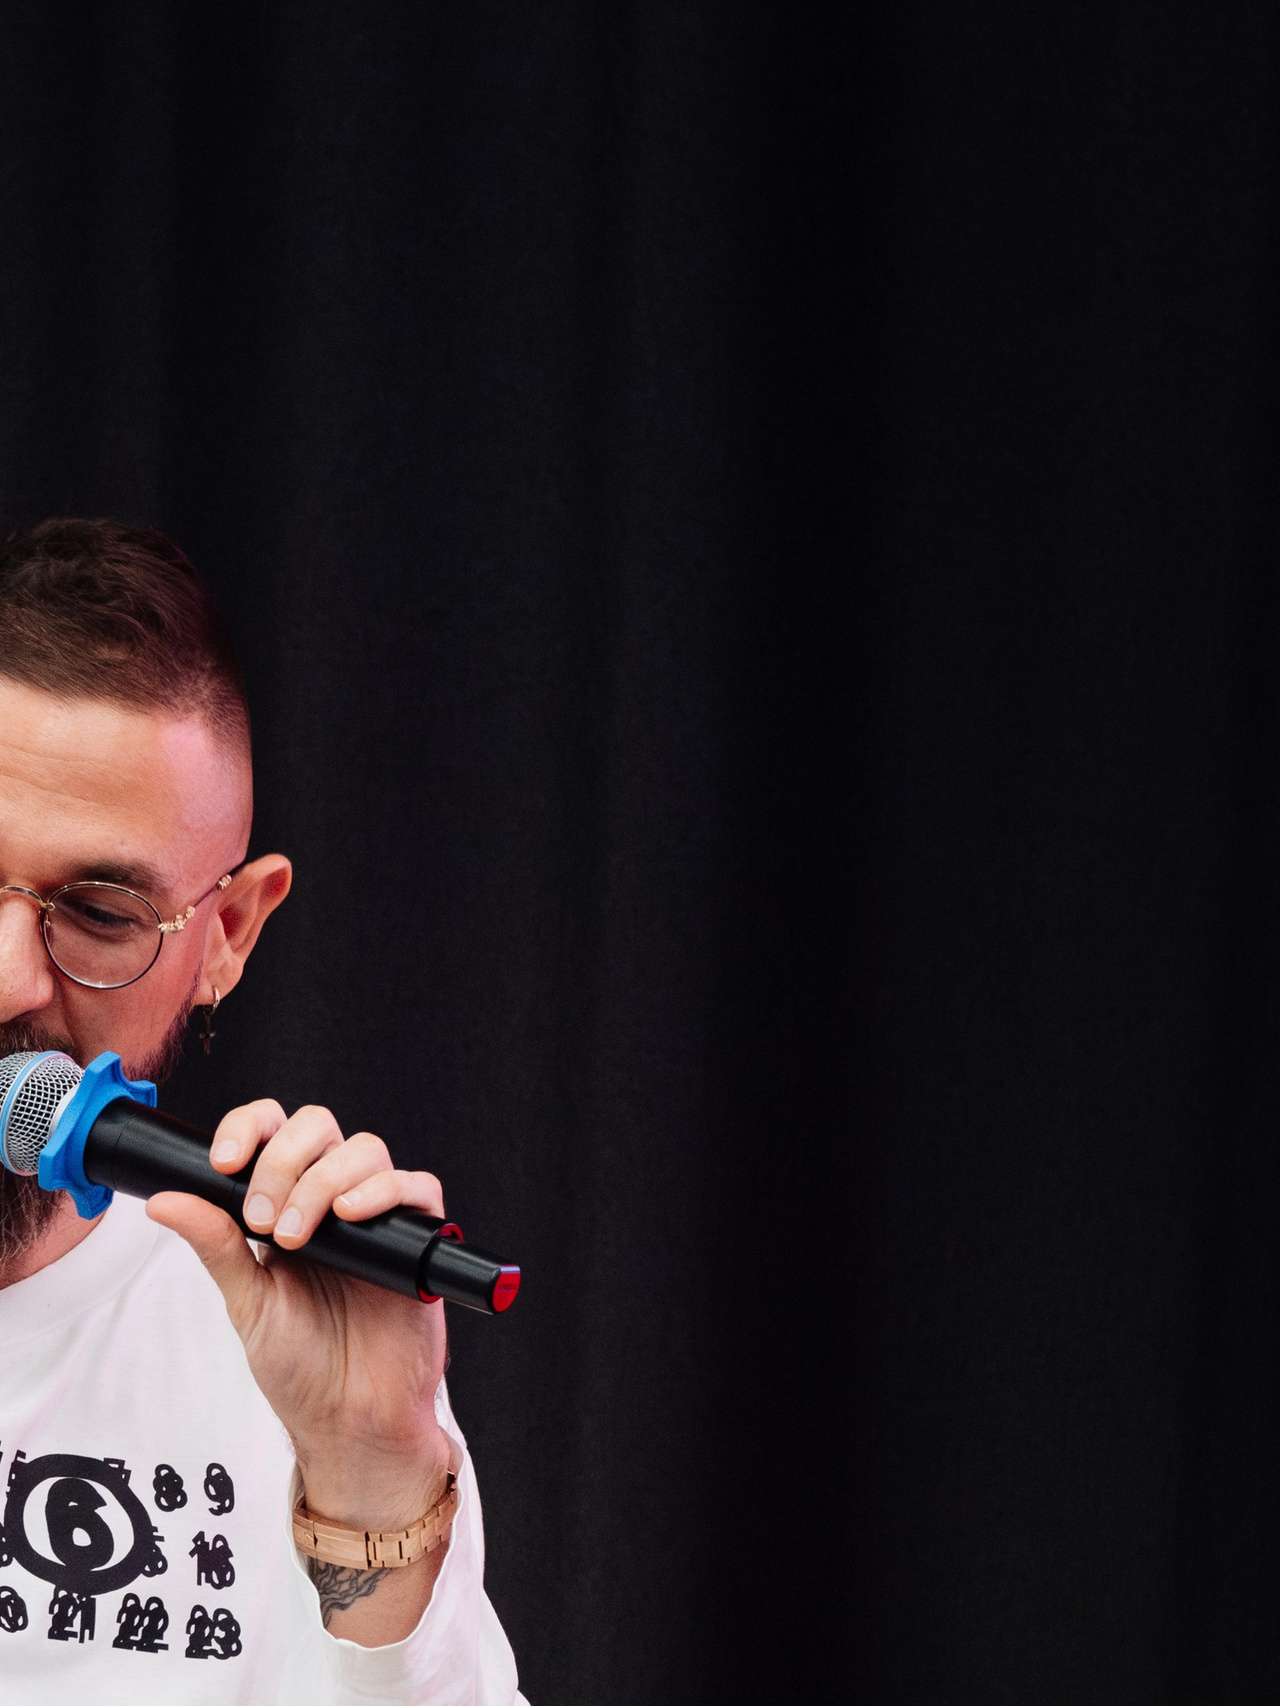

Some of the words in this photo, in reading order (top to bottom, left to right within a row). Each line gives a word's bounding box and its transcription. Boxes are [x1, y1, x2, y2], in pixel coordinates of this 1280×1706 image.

[45, 1477, 114, 1572] 6
[153, 1464, 187, 1512] 8
[204, 1463, 234, 1516] 9
[189, 1531, 235, 1590] 16
[48, 1586, 96, 1643] 21
[112, 1593, 169, 1653] 22
[185, 1605, 242, 1660] 23
